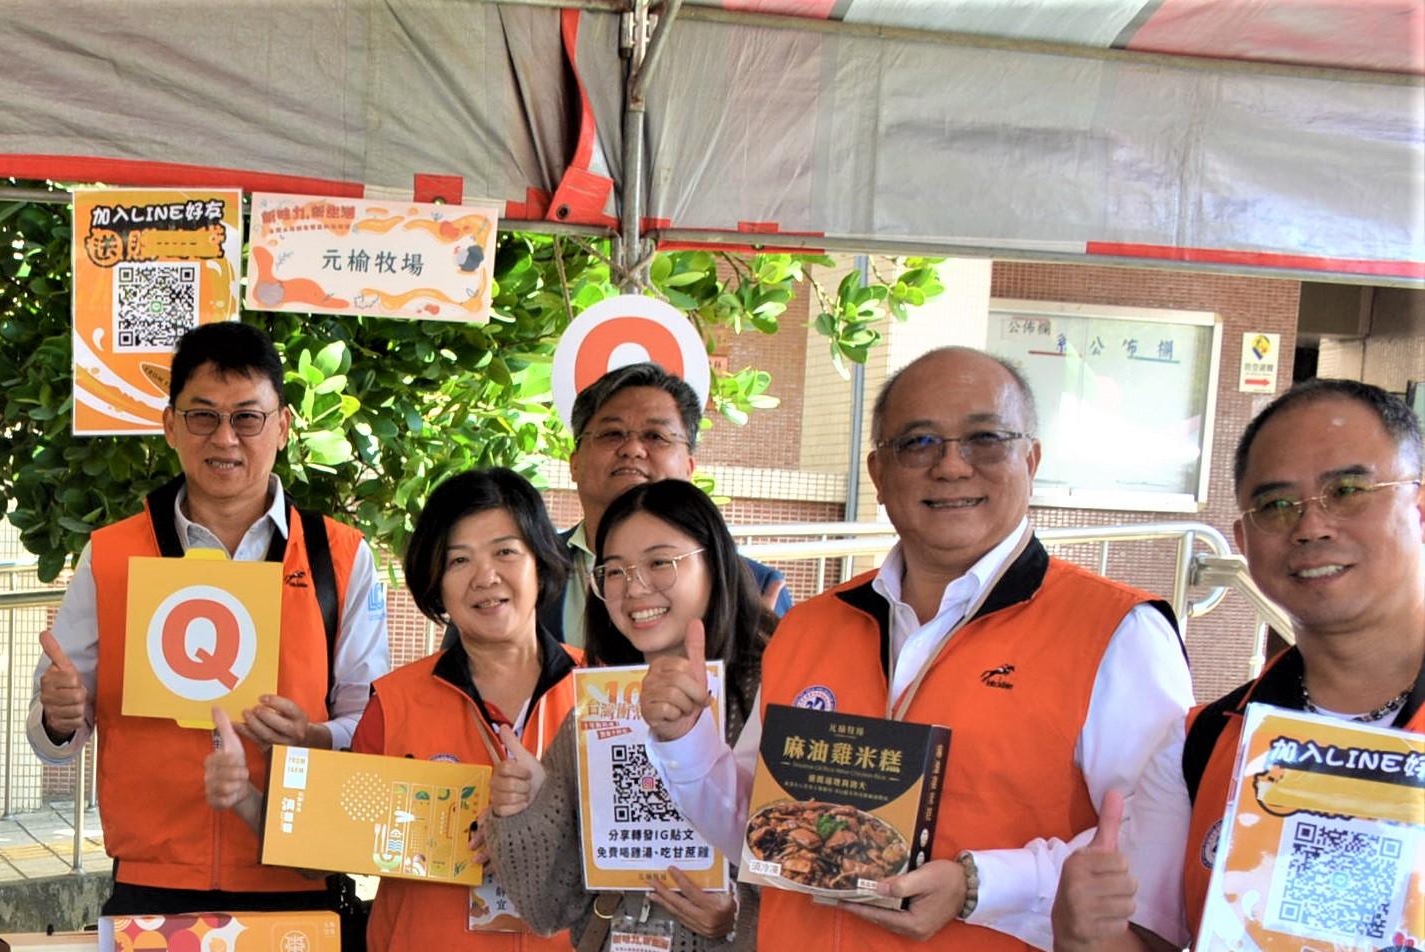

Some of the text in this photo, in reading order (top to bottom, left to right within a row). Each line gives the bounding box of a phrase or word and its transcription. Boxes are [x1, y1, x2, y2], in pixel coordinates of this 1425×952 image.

[92, 201, 224, 226] 加入LINE好友
[322, 249, 425, 276] 元榆牧場
[161, 599, 241, 691] Q
[783, 735, 903, 774] 麻油雞米糕
[608, 829, 695, 842] 分享轉發IG貼文
